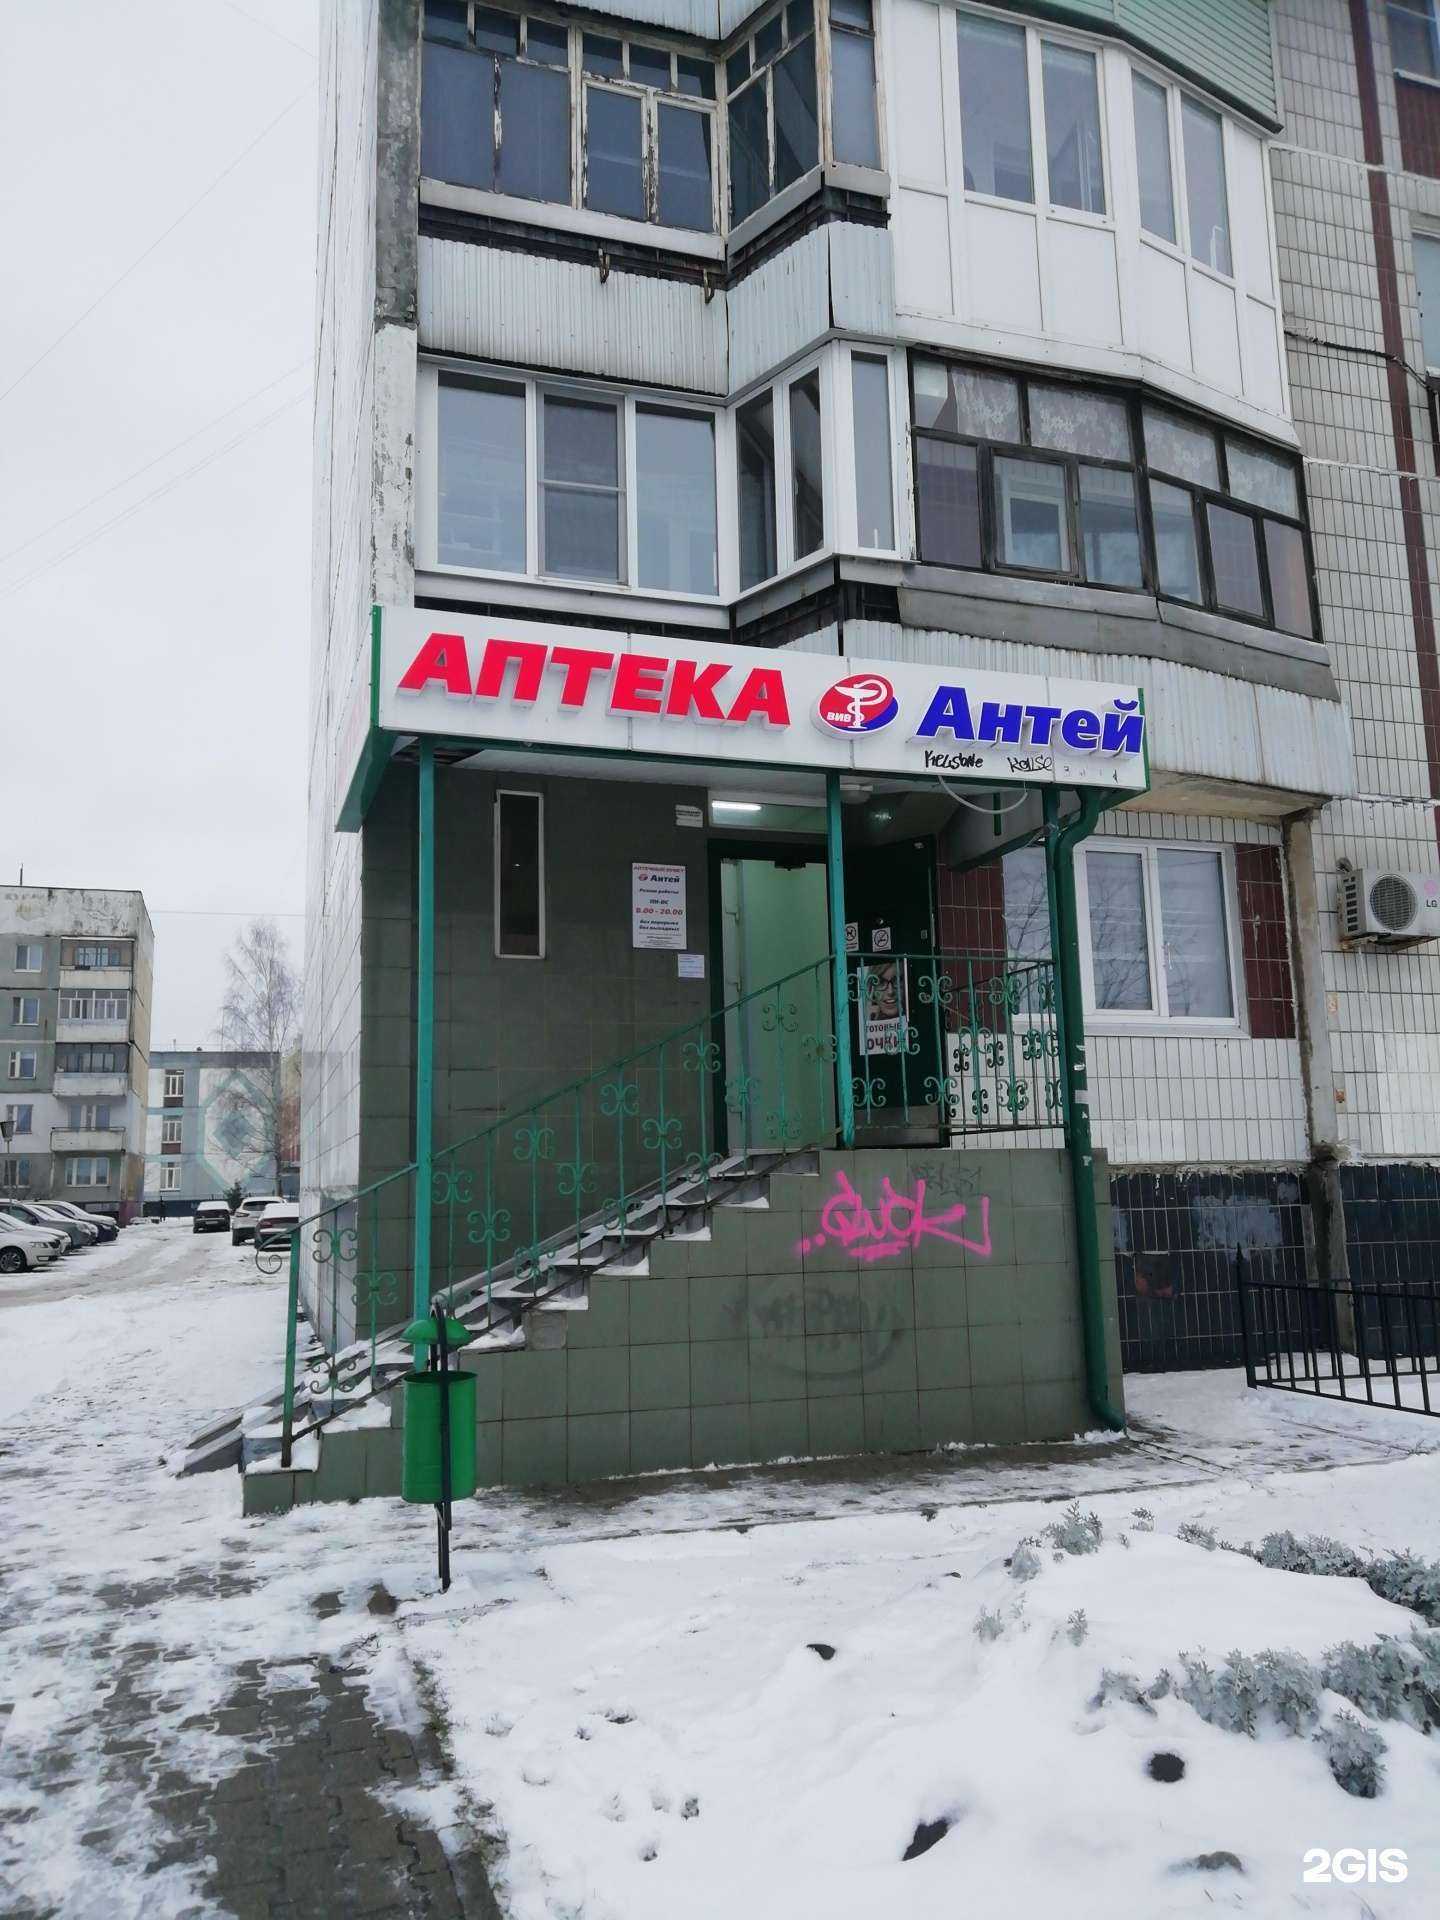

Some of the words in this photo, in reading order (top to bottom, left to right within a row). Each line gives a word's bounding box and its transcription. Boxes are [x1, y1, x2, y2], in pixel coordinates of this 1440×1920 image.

[398, 632, 791, 732] АПТЕКА
[826, 711, 852, 723] ВИВ
[916, 684, 1145, 755] Антей
[650, 874, 680, 883] Антей
[1426, 899, 1438, 908] LG
